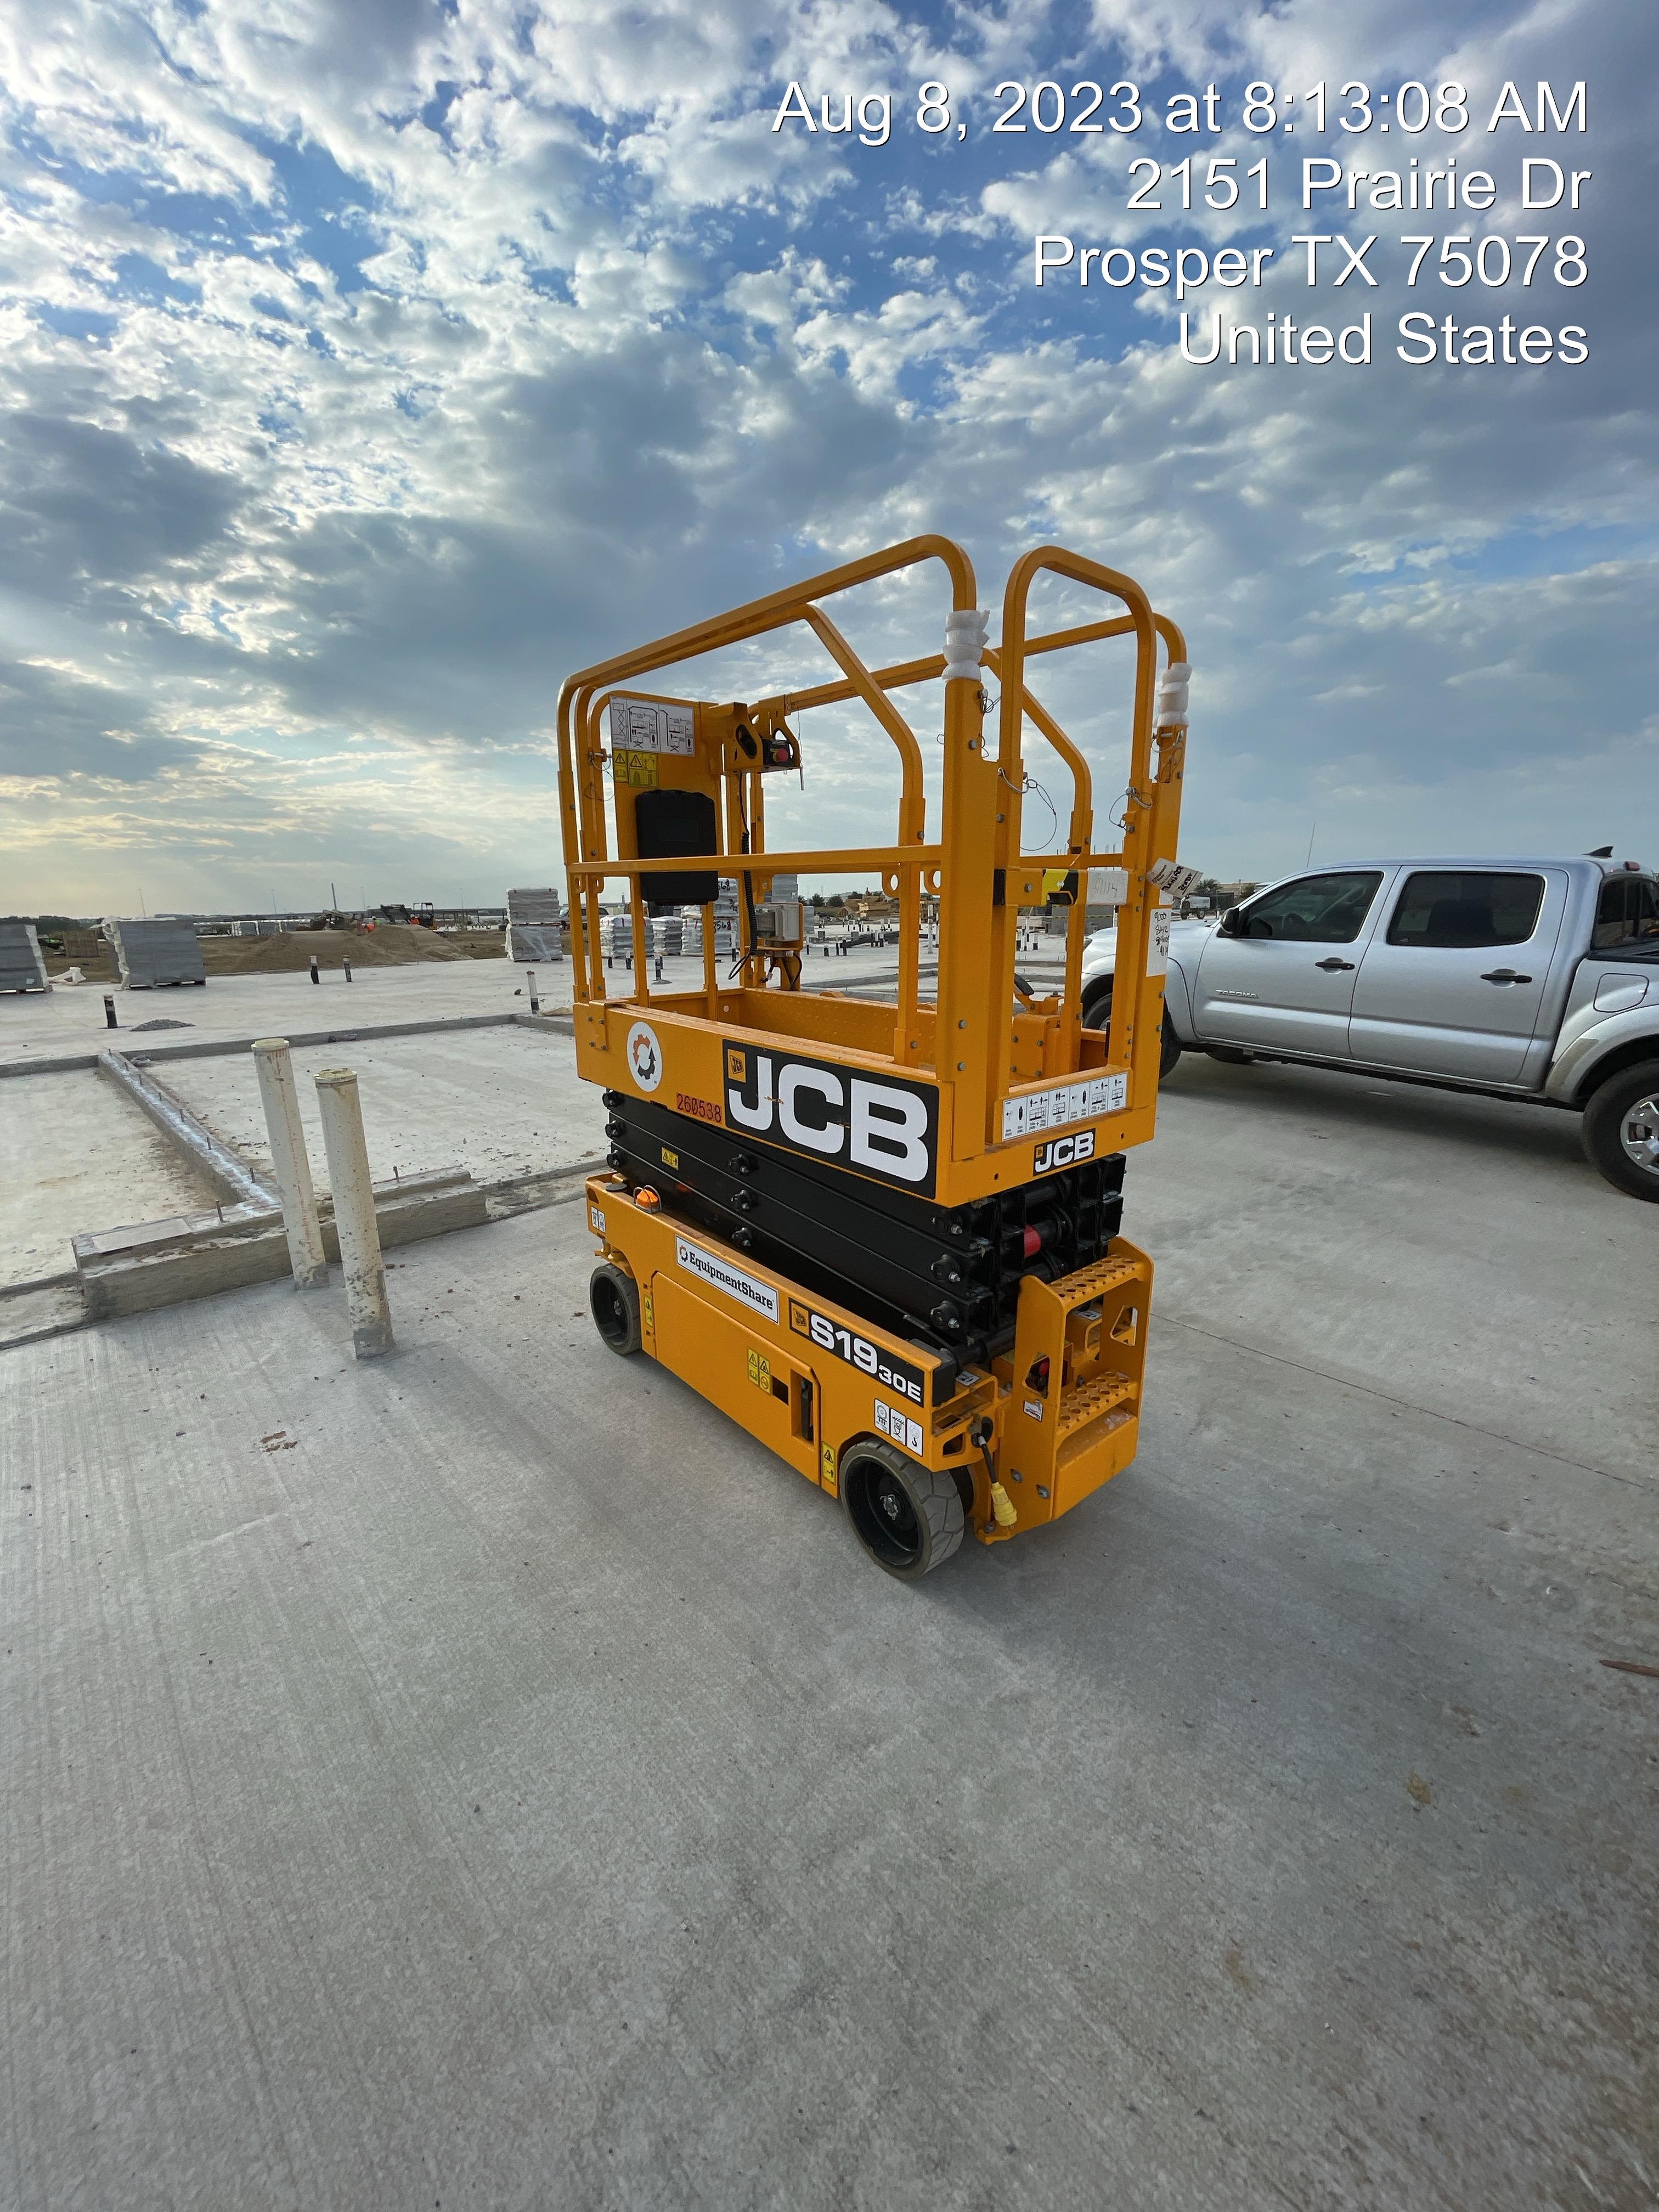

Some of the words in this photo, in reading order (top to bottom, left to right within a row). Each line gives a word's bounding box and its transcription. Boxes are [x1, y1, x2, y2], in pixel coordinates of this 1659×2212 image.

[1216, 990, 1259, 999] TACOMA
[677, 1093, 721, 1123] 260538
[729, 1056, 929, 1182] JCB
[1035, 1132, 1094, 1172] JCB
[689, 1251, 774, 1310] EquipmentShare
